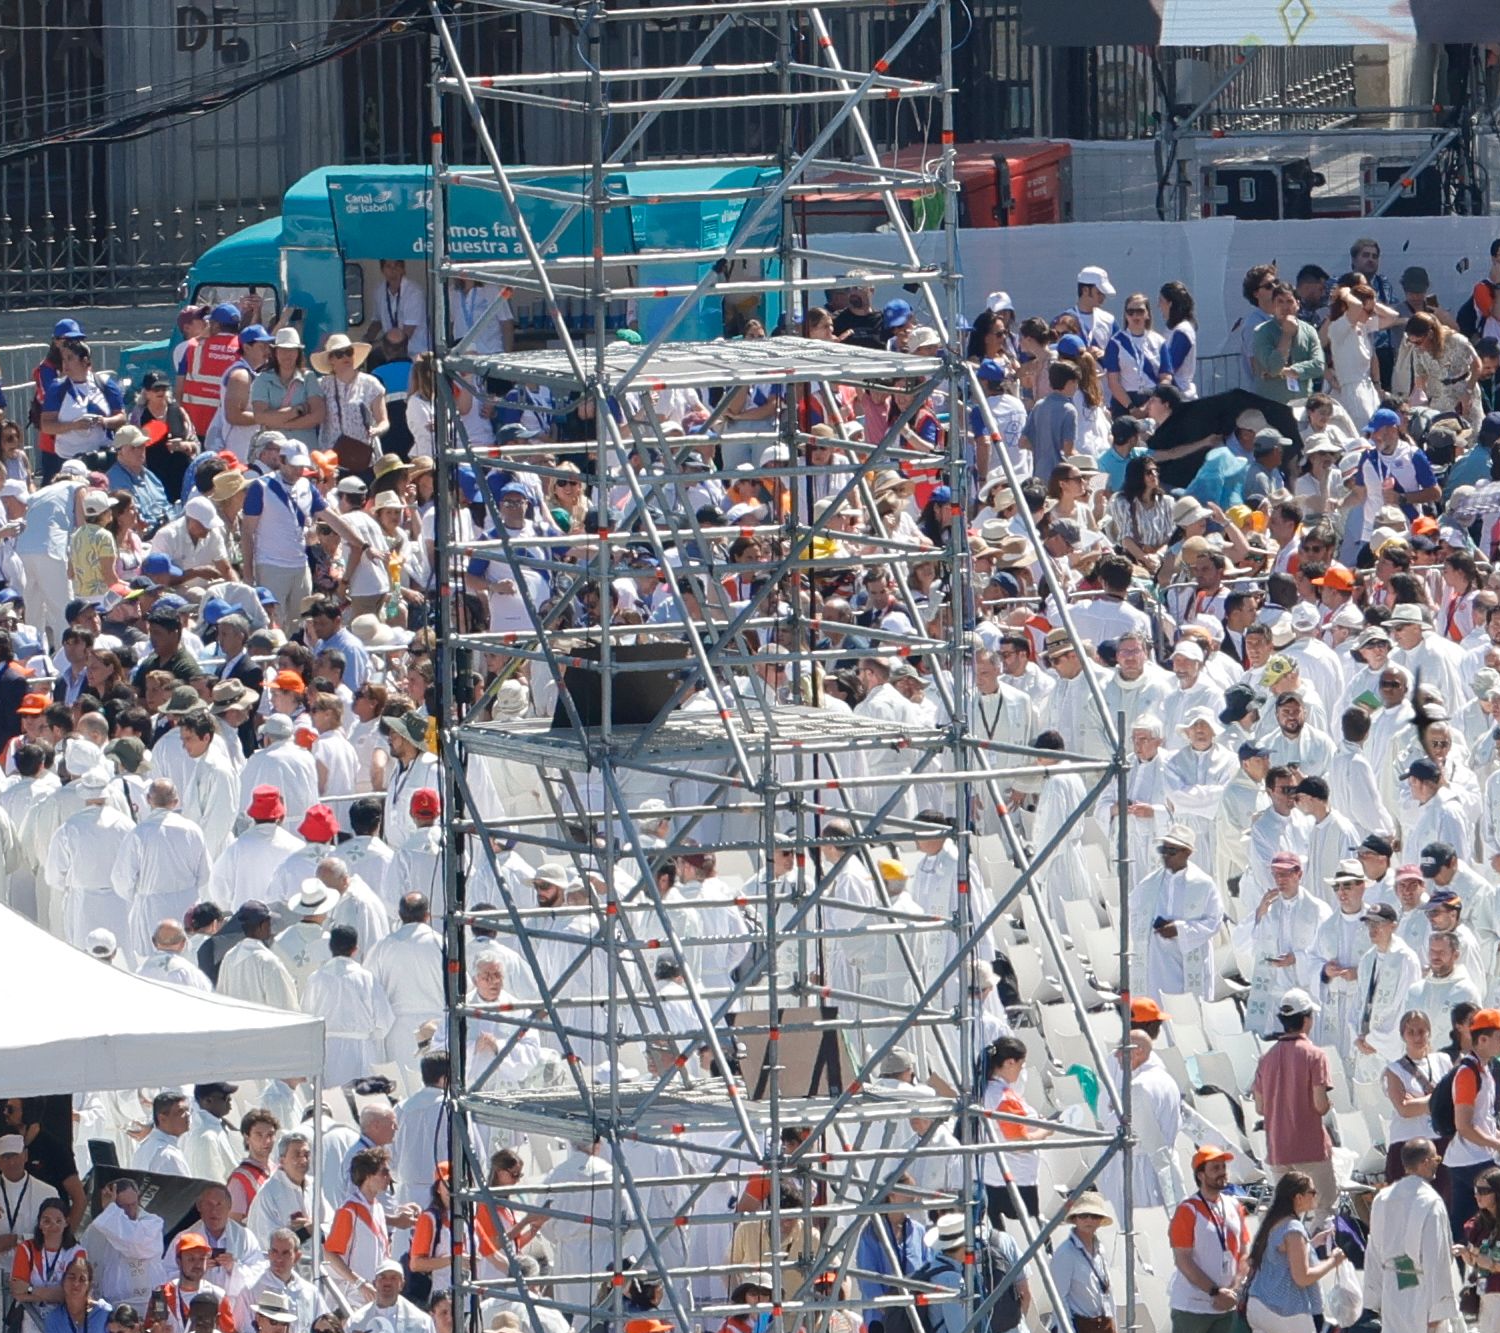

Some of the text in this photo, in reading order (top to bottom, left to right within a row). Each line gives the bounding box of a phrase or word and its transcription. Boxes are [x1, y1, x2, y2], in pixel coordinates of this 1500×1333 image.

[177, 4, 240, 52] DE
[345, 193, 372, 204] Canal
[426, 222, 489, 238] Smos
